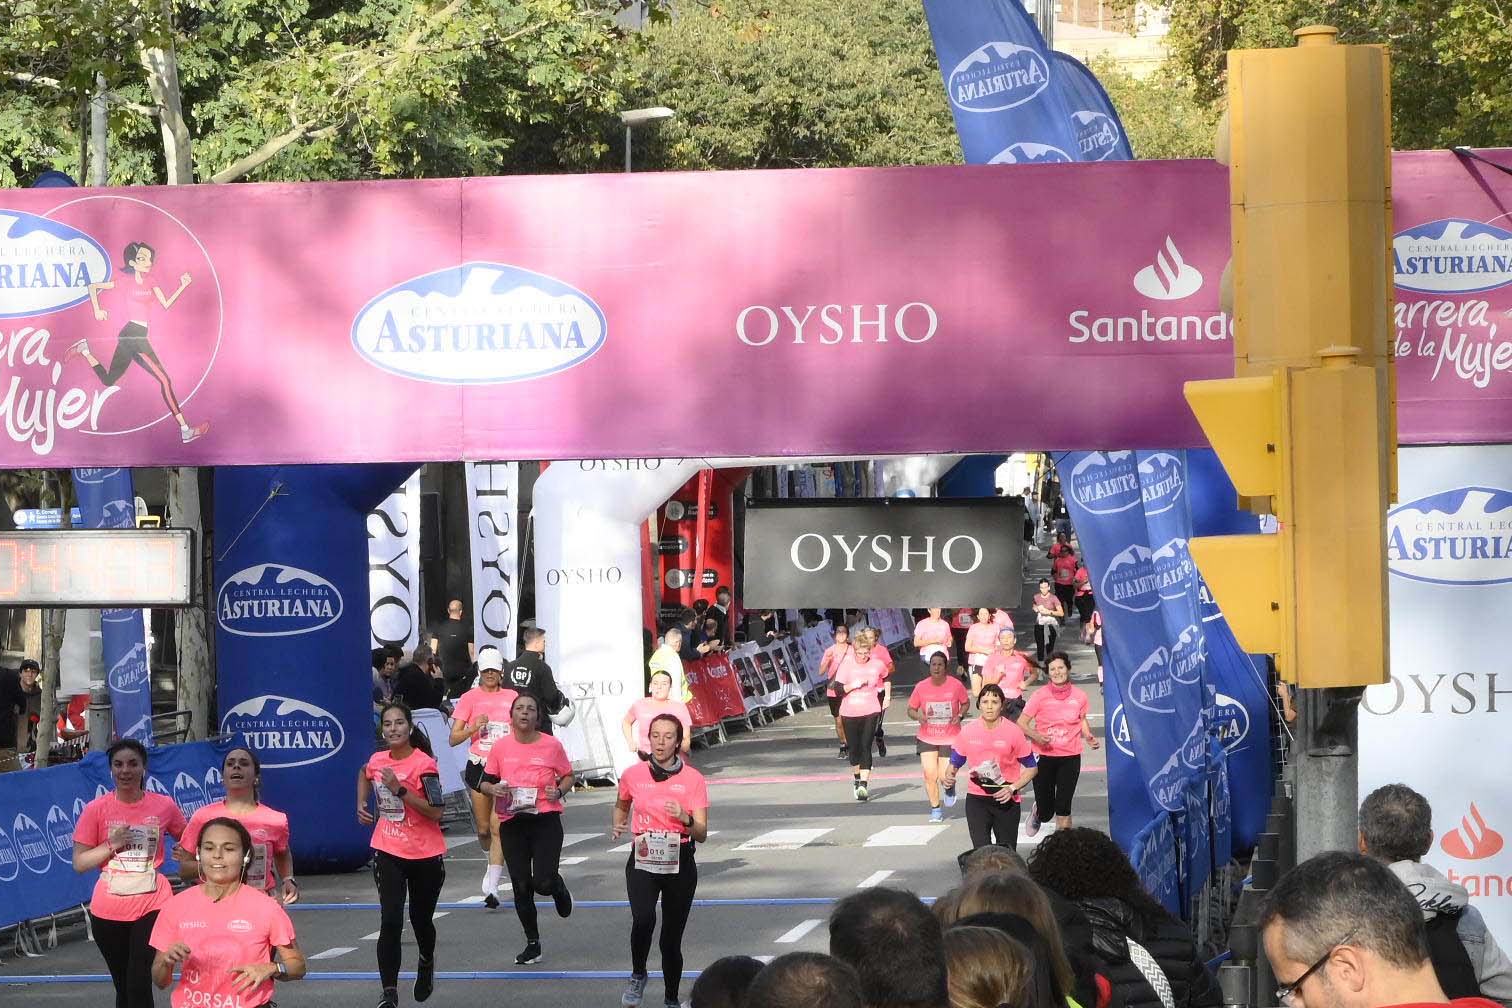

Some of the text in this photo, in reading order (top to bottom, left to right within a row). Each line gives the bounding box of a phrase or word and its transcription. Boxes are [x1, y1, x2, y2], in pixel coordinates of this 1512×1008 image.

[1408, 244, 1460, 253] CENTRAL
[373, 309, 588, 354] ASTURIANA
[735, 302, 938, 346] OYSHO
[1417, 330, 1435, 357] la
[1415, 520, 1482, 532] CENTRAL
[790, 533, 984, 574] OYSHO
[546, 566, 622, 586] OYSHO
[233, 588, 329, 598] CENTRAL LECHERA
[221, 593, 334, 621] ASTURIANA
[515, 670, 527, 680] BP
[236, 720, 330, 729] CENTRAL LECHERA
[243, 730, 335, 750] TURIANA
[183, 987, 243, 1008] DORSAL
